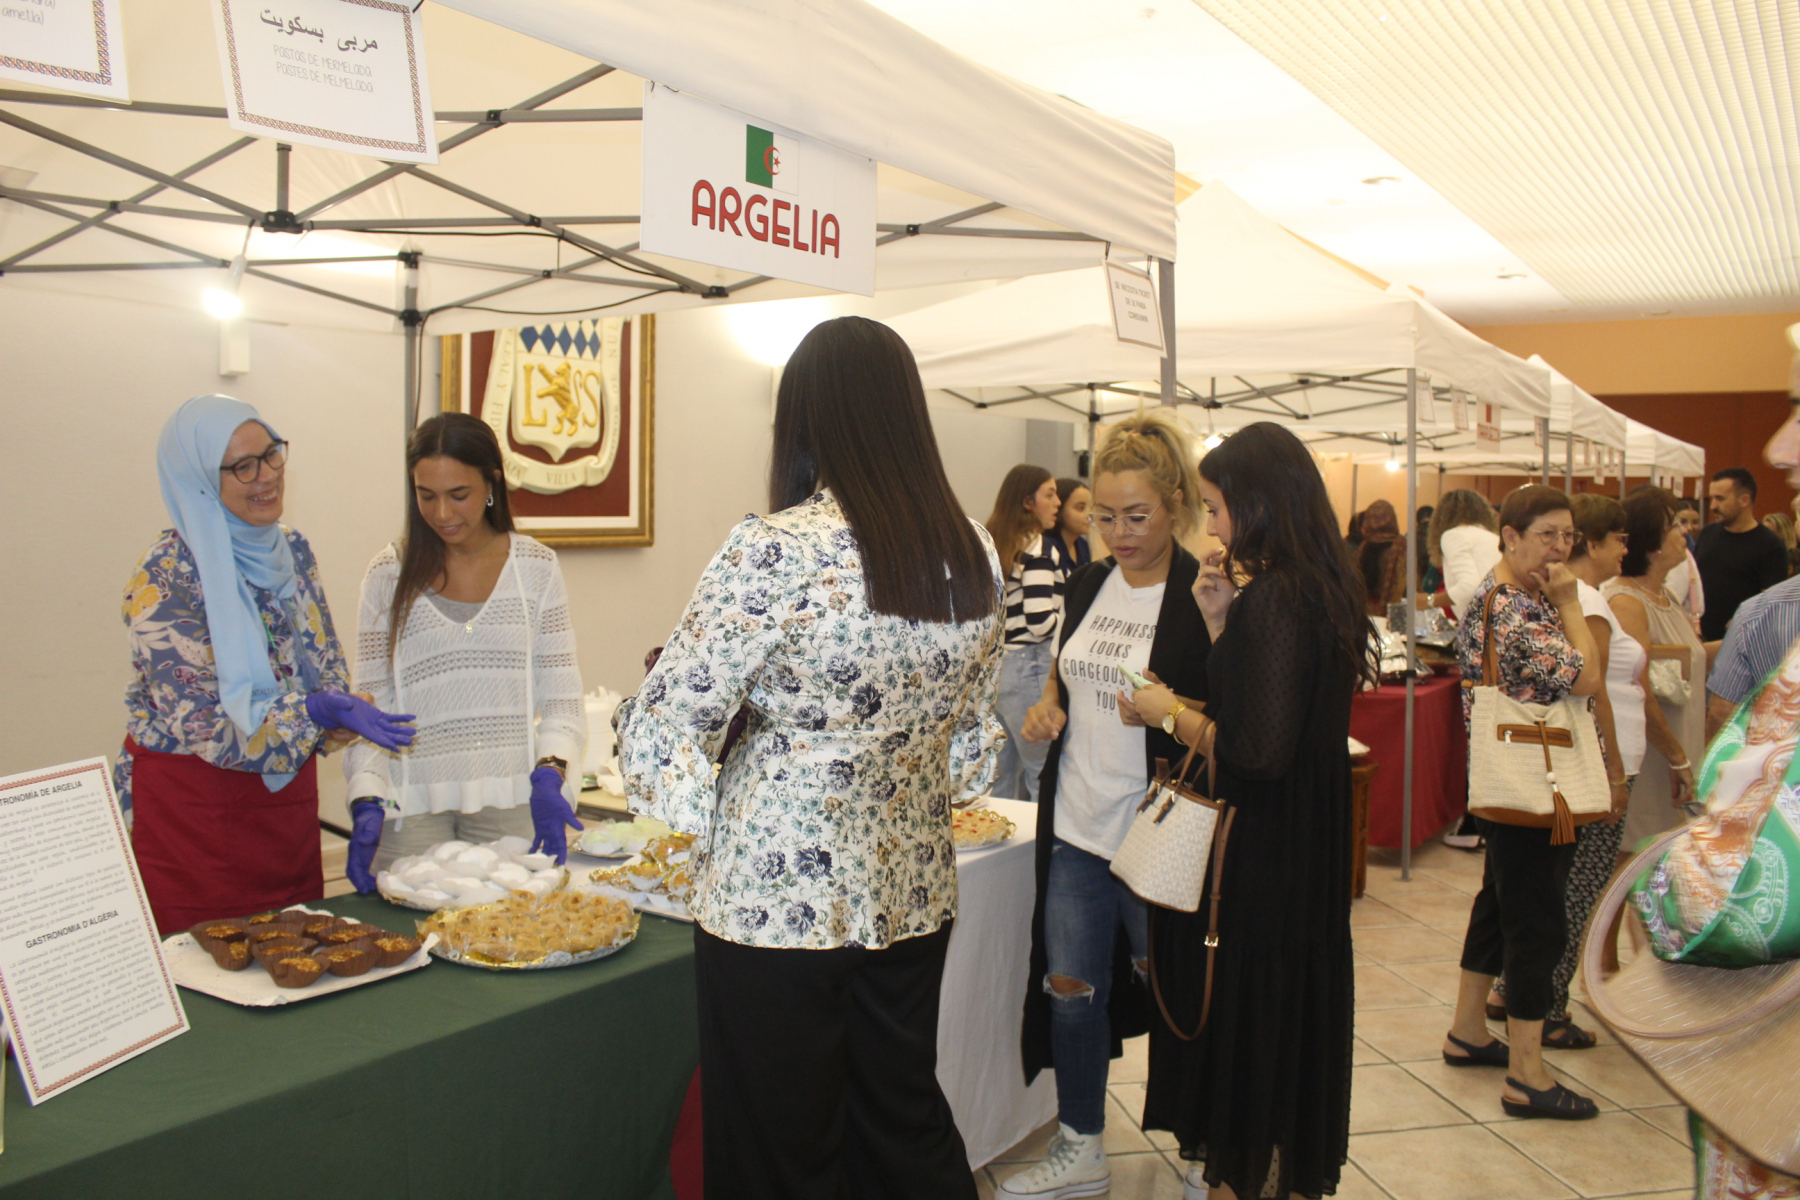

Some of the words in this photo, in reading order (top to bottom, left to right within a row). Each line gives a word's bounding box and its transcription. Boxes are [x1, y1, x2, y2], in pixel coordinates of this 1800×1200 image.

[259, 9, 324, 44] بسكويت
[307, 52, 320, 67] DE
[309, 70, 321, 84] DE
[692, 179, 840, 259] ARGELIA
[1089, 614, 1157, 640] HAPPINESS
[1089, 639, 1132, 659] LOOKS
[1063, 658, 1126, 686] GORGEOUS
[1096, 689, 1117, 711] YOU
[40, 787, 51, 798] DE
[52, 780, 83, 795] ARGELIA
[25, 922, 82, 949] GASTRONOMIA
